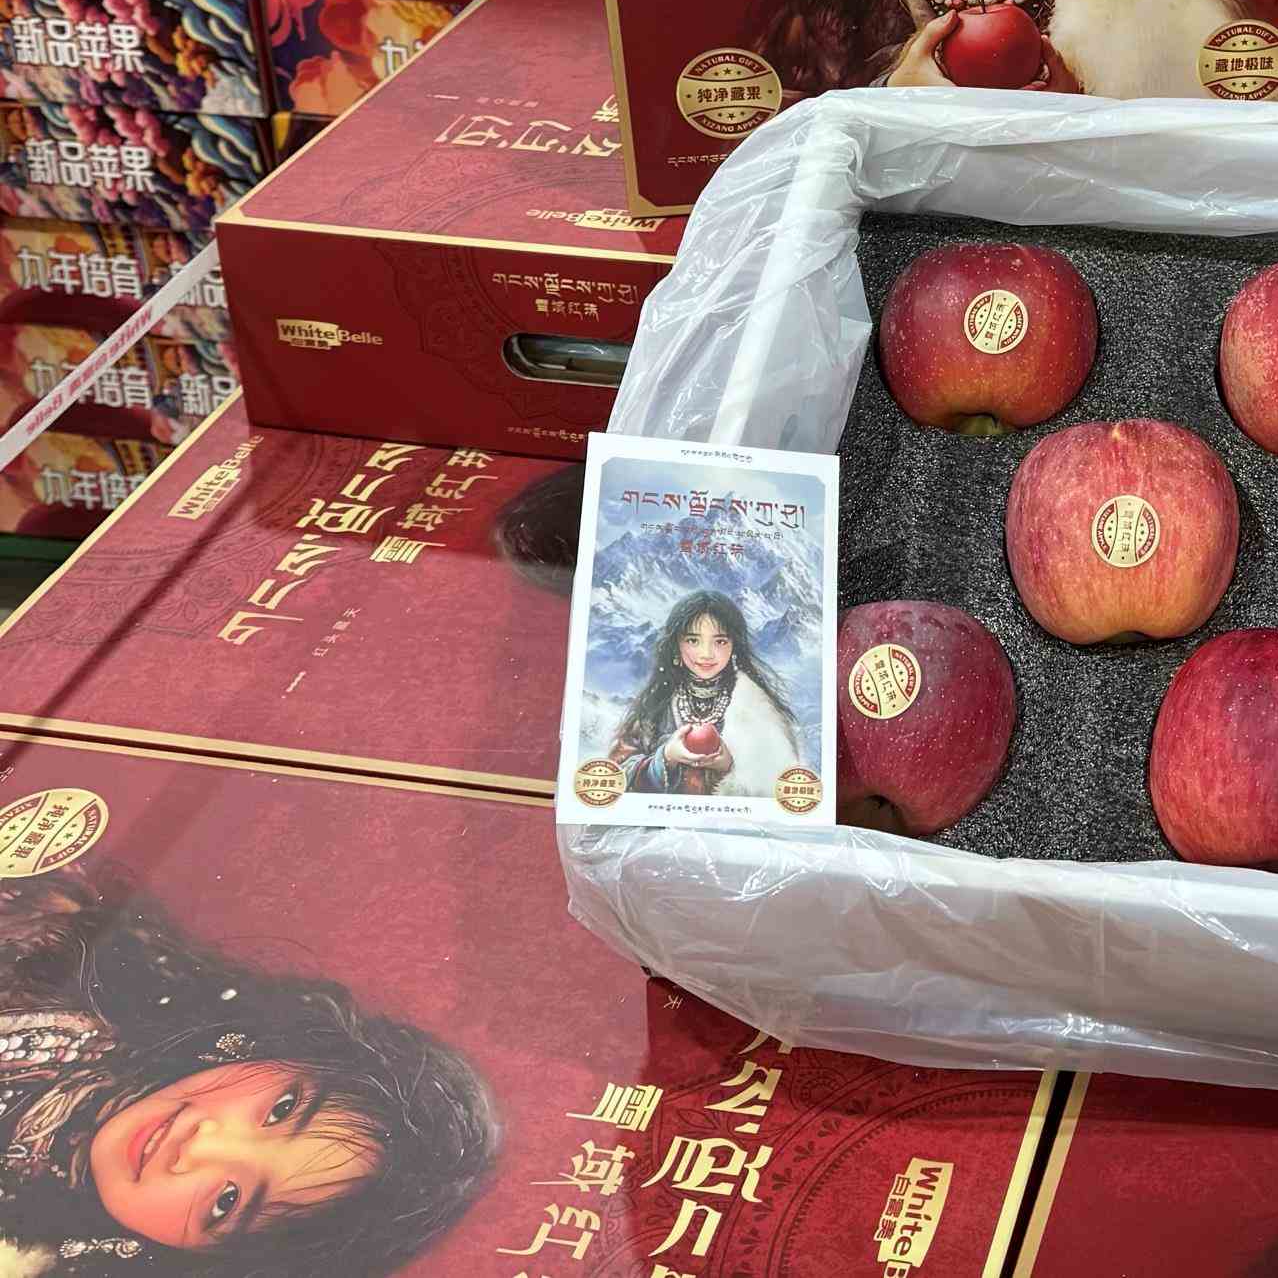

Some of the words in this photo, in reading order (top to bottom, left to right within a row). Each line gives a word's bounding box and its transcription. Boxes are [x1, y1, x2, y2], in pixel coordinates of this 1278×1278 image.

[13, 18, 146, 73] 新品苹果
[25, 138, 155, 193] 新品苹果
[497, 1082, 663, 1278] 雪域红
